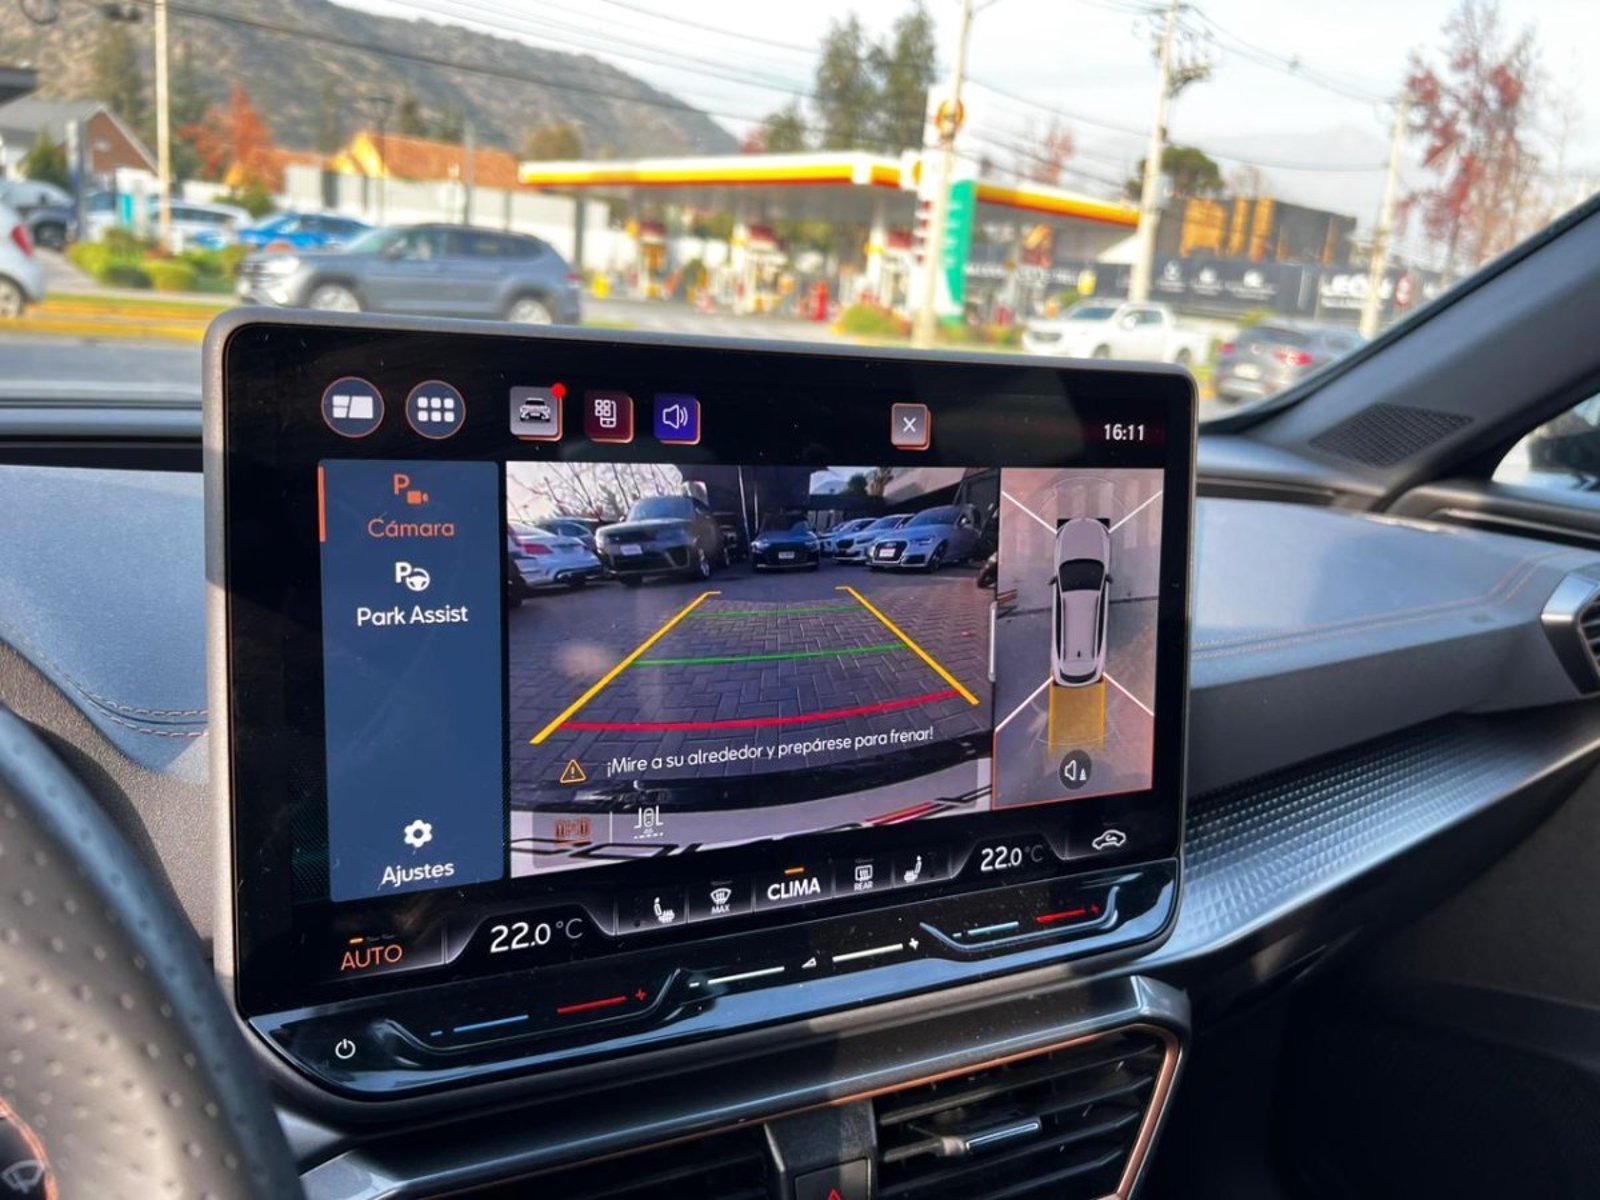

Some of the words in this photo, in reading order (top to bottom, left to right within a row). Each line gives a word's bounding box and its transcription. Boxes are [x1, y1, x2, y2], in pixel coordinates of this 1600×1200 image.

[1104, 423, 1145, 441] 16:11
[367, 517, 455, 538] Cámara
[356, 606, 406, 627] Park
[409, 604, 469, 625] Assist
[651, 757, 663, 770] a
[666, 755, 685, 769] su
[687, 744, 764, 765] alrededor
[766, 745, 776, 760] y
[778, 737, 851, 759] prepárese
[854, 733, 888, 751] para
[889, 726, 935, 744] frenar!
[980, 845, 1023, 872] 22.0
[380, 861, 456, 888] Ajustes
[853, 880, 874, 892] REAR
[766, 876, 822, 901] CLIMA
[711, 903, 731, 915] MAX
[489, 921, 552, 954] 22.0
[340, 944, 403, 972] AUTO
